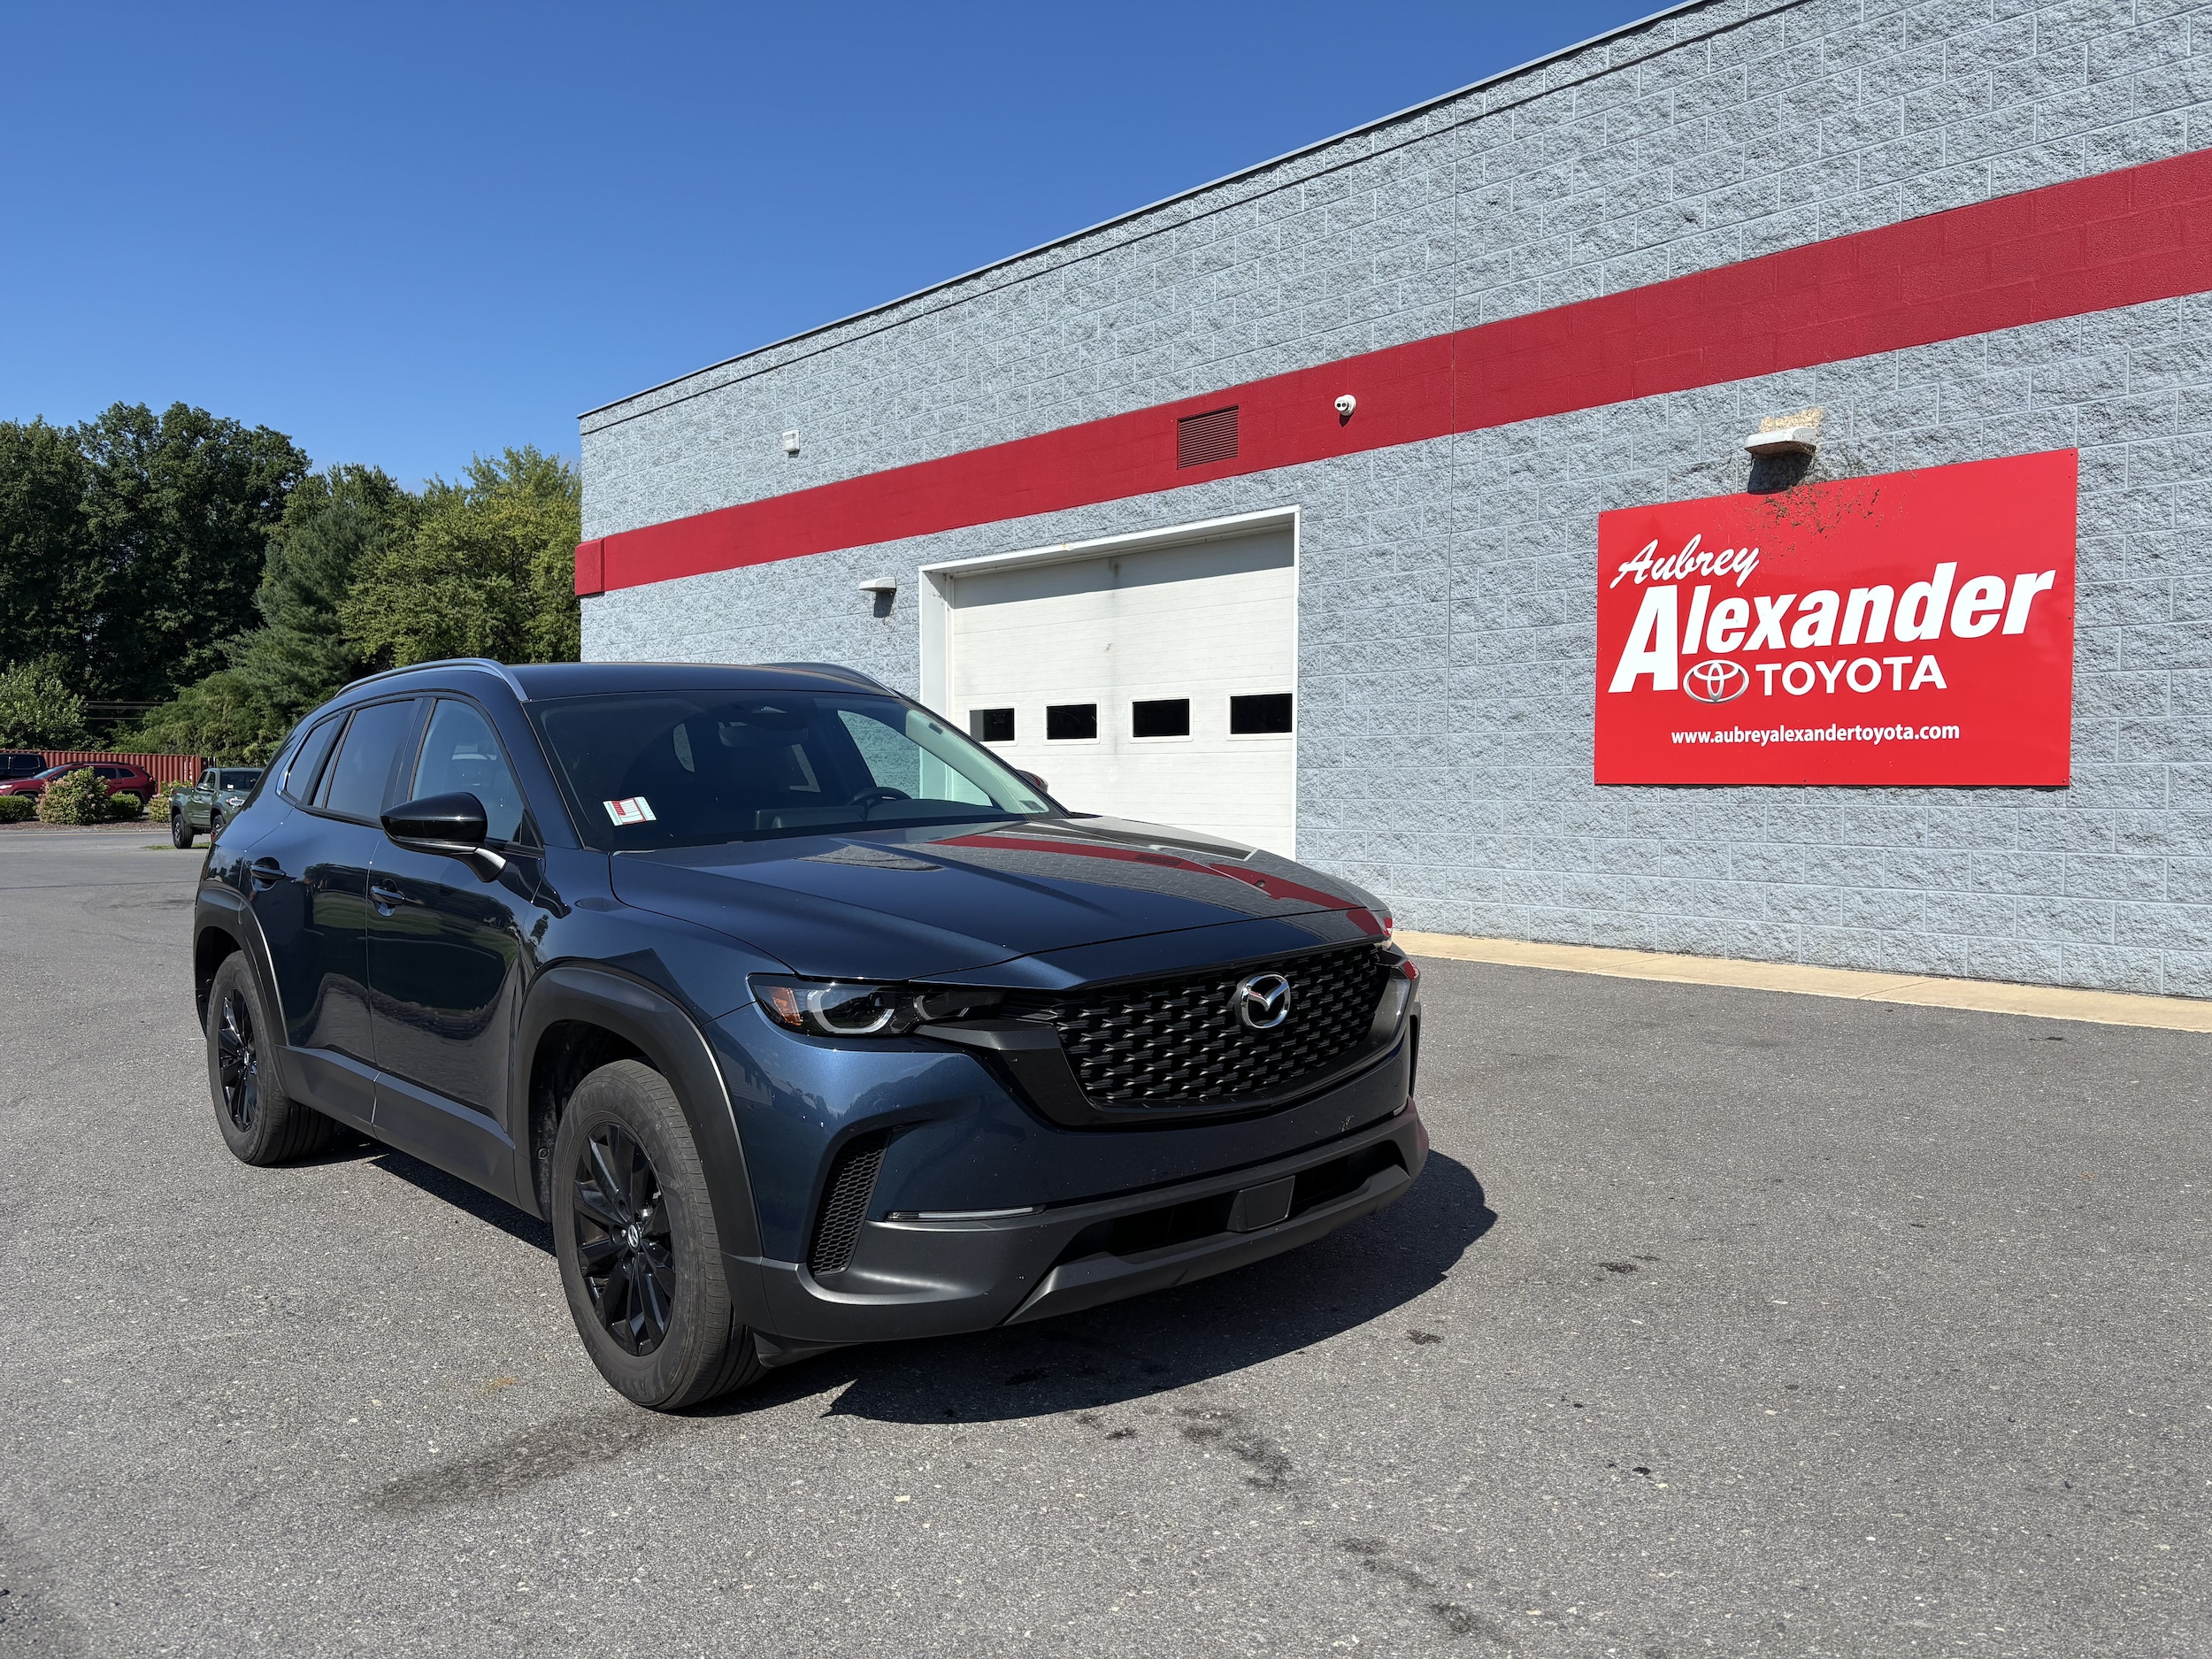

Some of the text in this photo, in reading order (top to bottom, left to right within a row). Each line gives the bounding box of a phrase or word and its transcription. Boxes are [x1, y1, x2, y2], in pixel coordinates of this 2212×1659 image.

[1609, 534, 1760, 589] Aubrey
[1608, 561, 2056, 693] Alexander
[1755, 655, 1947, 697] TOYOTA
[1671, 723, 1960, 748] www.aubreyalexandertoyota.com
